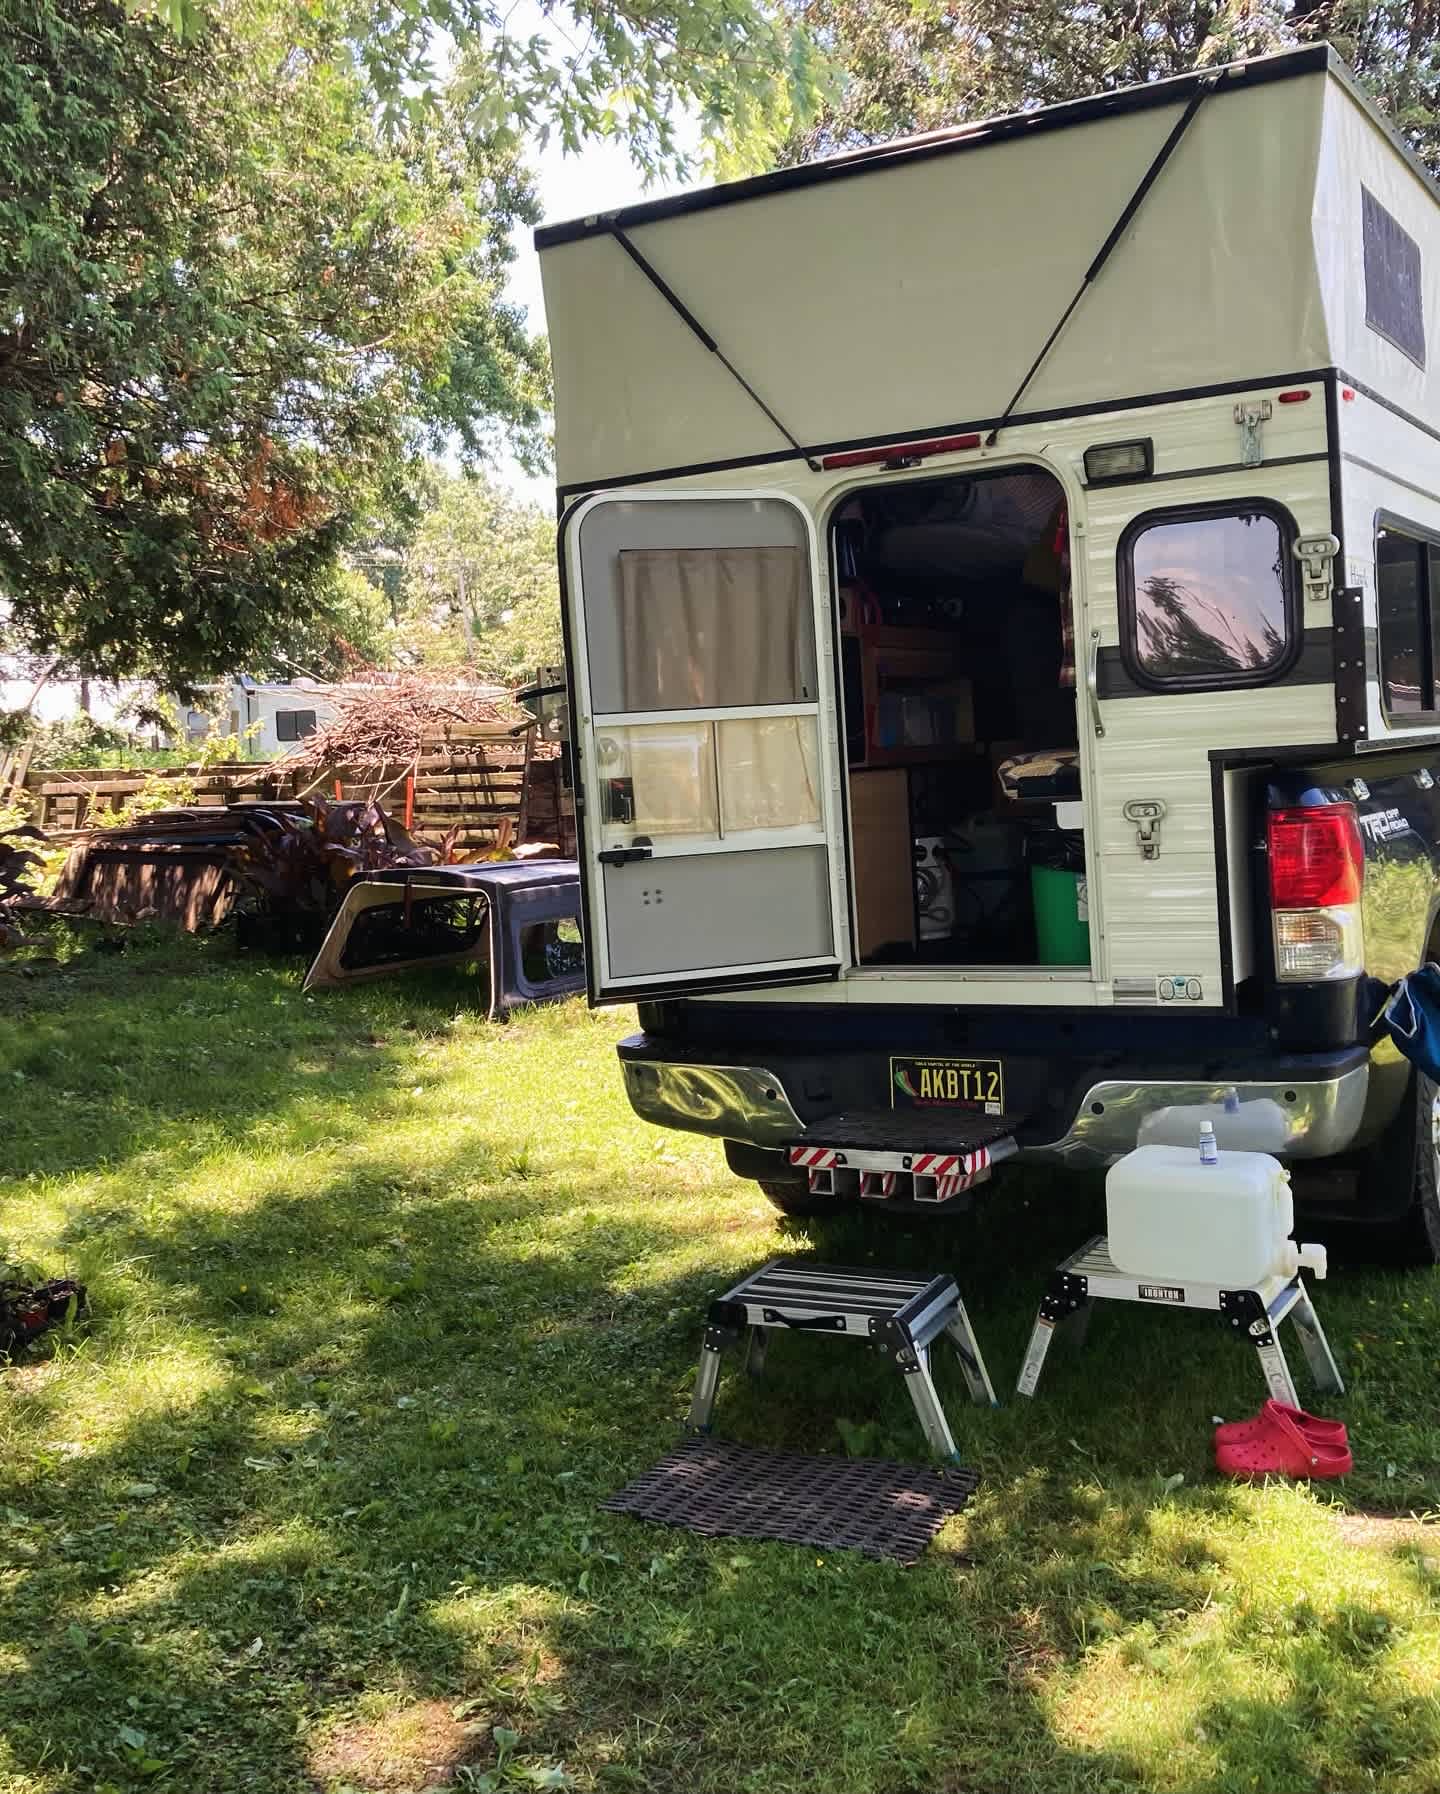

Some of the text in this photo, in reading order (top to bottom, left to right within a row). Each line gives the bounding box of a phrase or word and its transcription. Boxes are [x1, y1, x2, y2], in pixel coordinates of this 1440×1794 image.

[1359, 811, 1390, 841] TRD
[921, 1069, 1000, 1101] AKBT12
[1144, 1288, 1179, 1299] IRONTON
